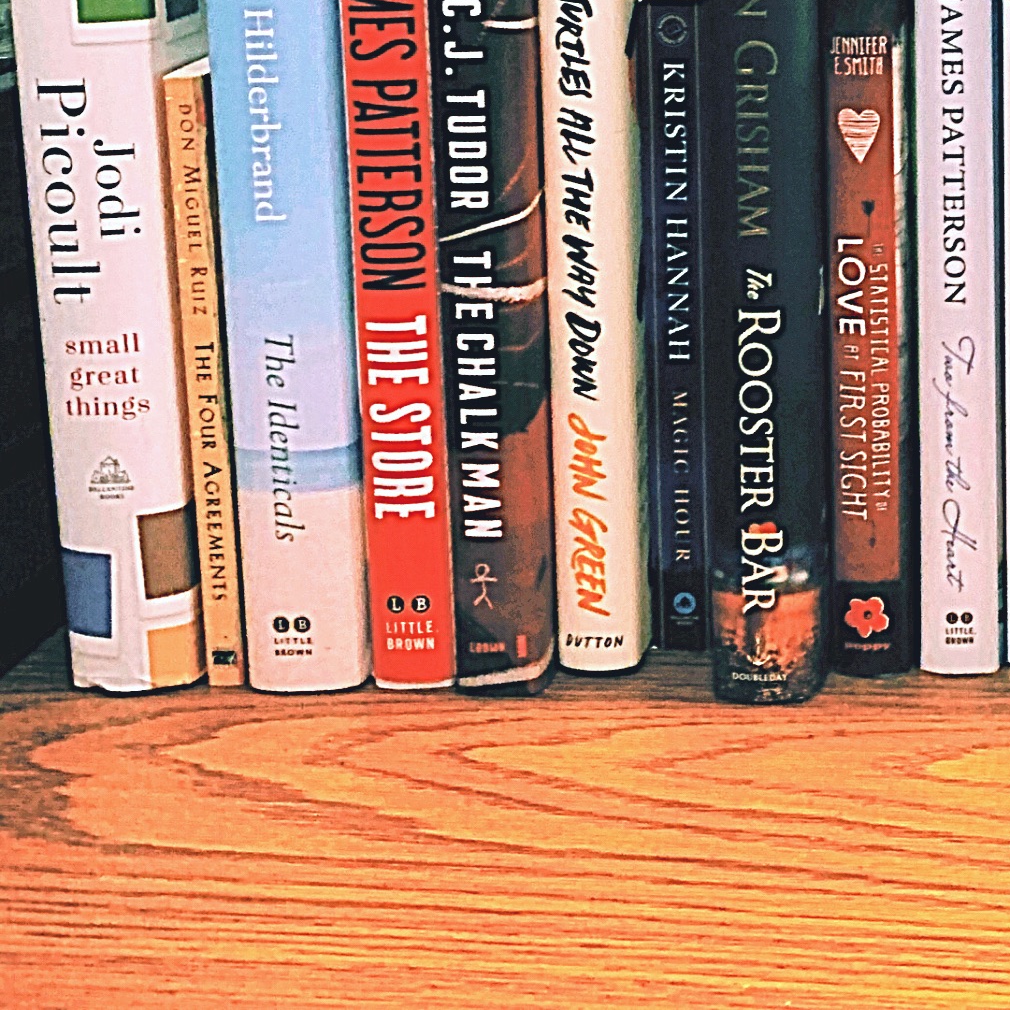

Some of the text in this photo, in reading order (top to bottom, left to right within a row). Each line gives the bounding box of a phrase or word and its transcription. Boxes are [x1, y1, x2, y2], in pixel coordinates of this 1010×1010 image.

[830, 36, 888, 55] JENNIFER
[844, 56, 883, 76] SMITH
[244, 9, 287, 223] Hilderbrand
[446, 90, 489, 210] TUDOR
[557, 107, 596, 166] ALL
[733, 40, 779, 238] GRISHAM
[36, 77, 101, 305] Picoult
[93, 138, 142, 240] Jodi
[178, 104, 208, 315] DON MIGUEL RUIZ
[352, 79, 427, 291] PATTERSON
[561, 167, 595, 235] THE
[663, 62, 691, 362] KRISTIN HANNAH
[940, 106, 967, 305] PATTERSON
[452, 250, 495, 320] THE
[562, 234, 598, 317] WAY
[837, 238, 866, 336] LOVE
[869, 263, 890, 376] STATISTICAL
[65, 333, 140, 354] small
[70, 367, 140, 391] great
[365, 315, 431, 386] THE
[565, 311, 602, 401] DOWN
[942, 336, 976, 387] Two
[66, 396, 151, 421] things
[456, 333, 499, 449] CHALK
[839, 370, 867, 443] FIRST
[932, 377, 969, 457] from
[194, 342, 228, 601] THE FOUR AGREEMENTS
[264, 334, 306, 543] The Identicals
[369, 403, 436, 520] STORE
[672, 391, 691, 562] MAGIC HOUR
[737, 268, 784, 614] The ROOSTER BAR
[871, 382, 891, 498] PROBABILITY
[945, 456, 971, 493] the
[462, 463, 503, 539] MAN
[567, 412, 611, 617] JOHN GREEN
[839, 450, 868, 521] SIGHT
[941, 498, 977, 593] Heart
[387, 637, 434, 651] BROWN
[566, 633, 624, 648] DUTTON
[732, 671, 788, 682] DOUBLEDAY
